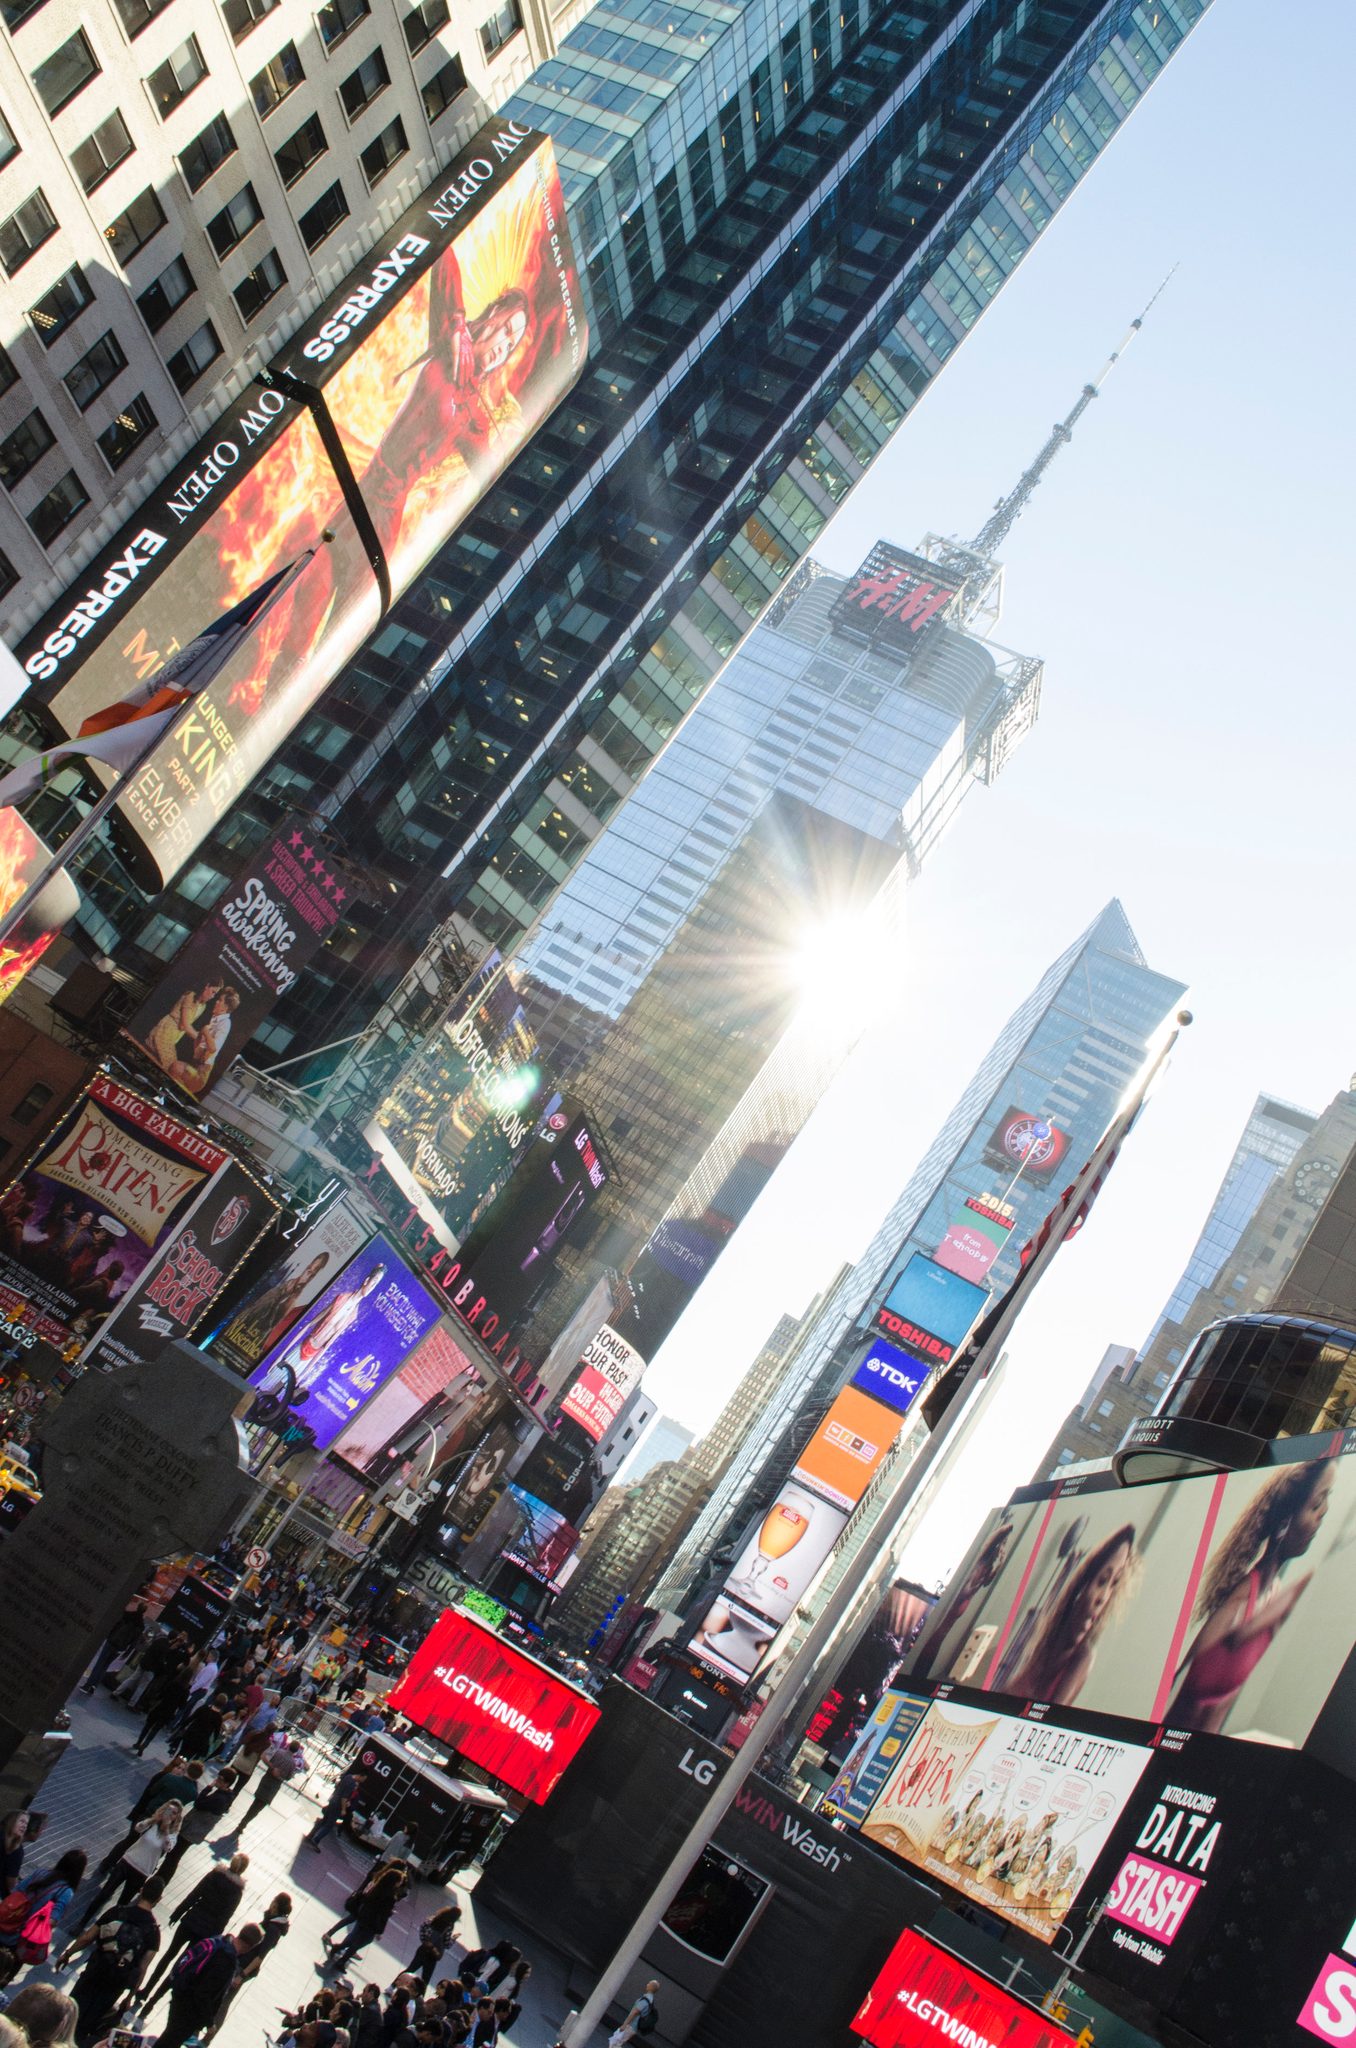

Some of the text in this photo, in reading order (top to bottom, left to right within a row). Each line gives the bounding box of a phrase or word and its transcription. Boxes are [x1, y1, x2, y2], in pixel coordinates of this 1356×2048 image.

[426, 158, 494, 229] OPEN
[303, 233, 430, 362] EXPRESS
[550, 235, 563, 268] CAN
[558, 271, 577, 335] PREPARE
[166, 378, 291, 524] OW OPEN
[25, 528, 168, 680] EXPRESS
[168, 757, 198, 808] PART 2
[270, 864, 296, 897] SHEER
[235, 878, 296, 951] SPRING
[222, 902, 295, 995] awakening
[456, 1019, 493, 1080] OFFICE
[112, 1087, 143, 1122] BIG,
[147, 1111, 177, 1137] FAT
[539, 1130, 557, 1143] LG
[96, 1118, 182, 1179] SOMETHING
[575, 1128, 588, 1150] LG
[417, 1135, 455, 1195] VORNADO
[966, 1199, 1015, 1230] TOSHIBA
[2, 1273, 24, 1290] BOOK
[166, 1230, 223, 1294] SCHOOL
[43, 1282, 79, 1309] ALADDIN
[146, 1263, 206, 1326] ROCK
[370, 1292, 391, 1312] YOU
[400, 1205, 461, 1287] 1540
[454, 1279, 549, 1406] BROADWAY
[595, 1329, 630, 1366] HONOR
[879, 1310, 954, 1361] TOSHIBA
[583, 1344, 630, 1388] OUR PAST
[881, 1365, 918, 1393] TDK
[93, 1412, 199, 1491] FRANCIS DUFFY
[1, 1501, 15, 1514] LG
[181, 1586, 191, 1597] LG
[699, 1661, 728, 1681] SONY
[433, 1665, 554, 1752] #LGTWINWash
[1041, 1733, 1082, 1767] FAT
[1160, 1739, 1184, 1750] MARQUIS
[1165, 1729, 1192, 1741] MARRIOTT
[374, 1760, 392, 1778] LG
[411, 1787, 420, 1797] LG
[678, 1748, 717, 1786] LG
[1161, 1784, 1217, 1814] INTRODUCING
[1135, 1803, 1222, 1872] DATA
[1107, 1860, 1197, 1937] STASH
[1313, 1970, 1356, 2039] S
